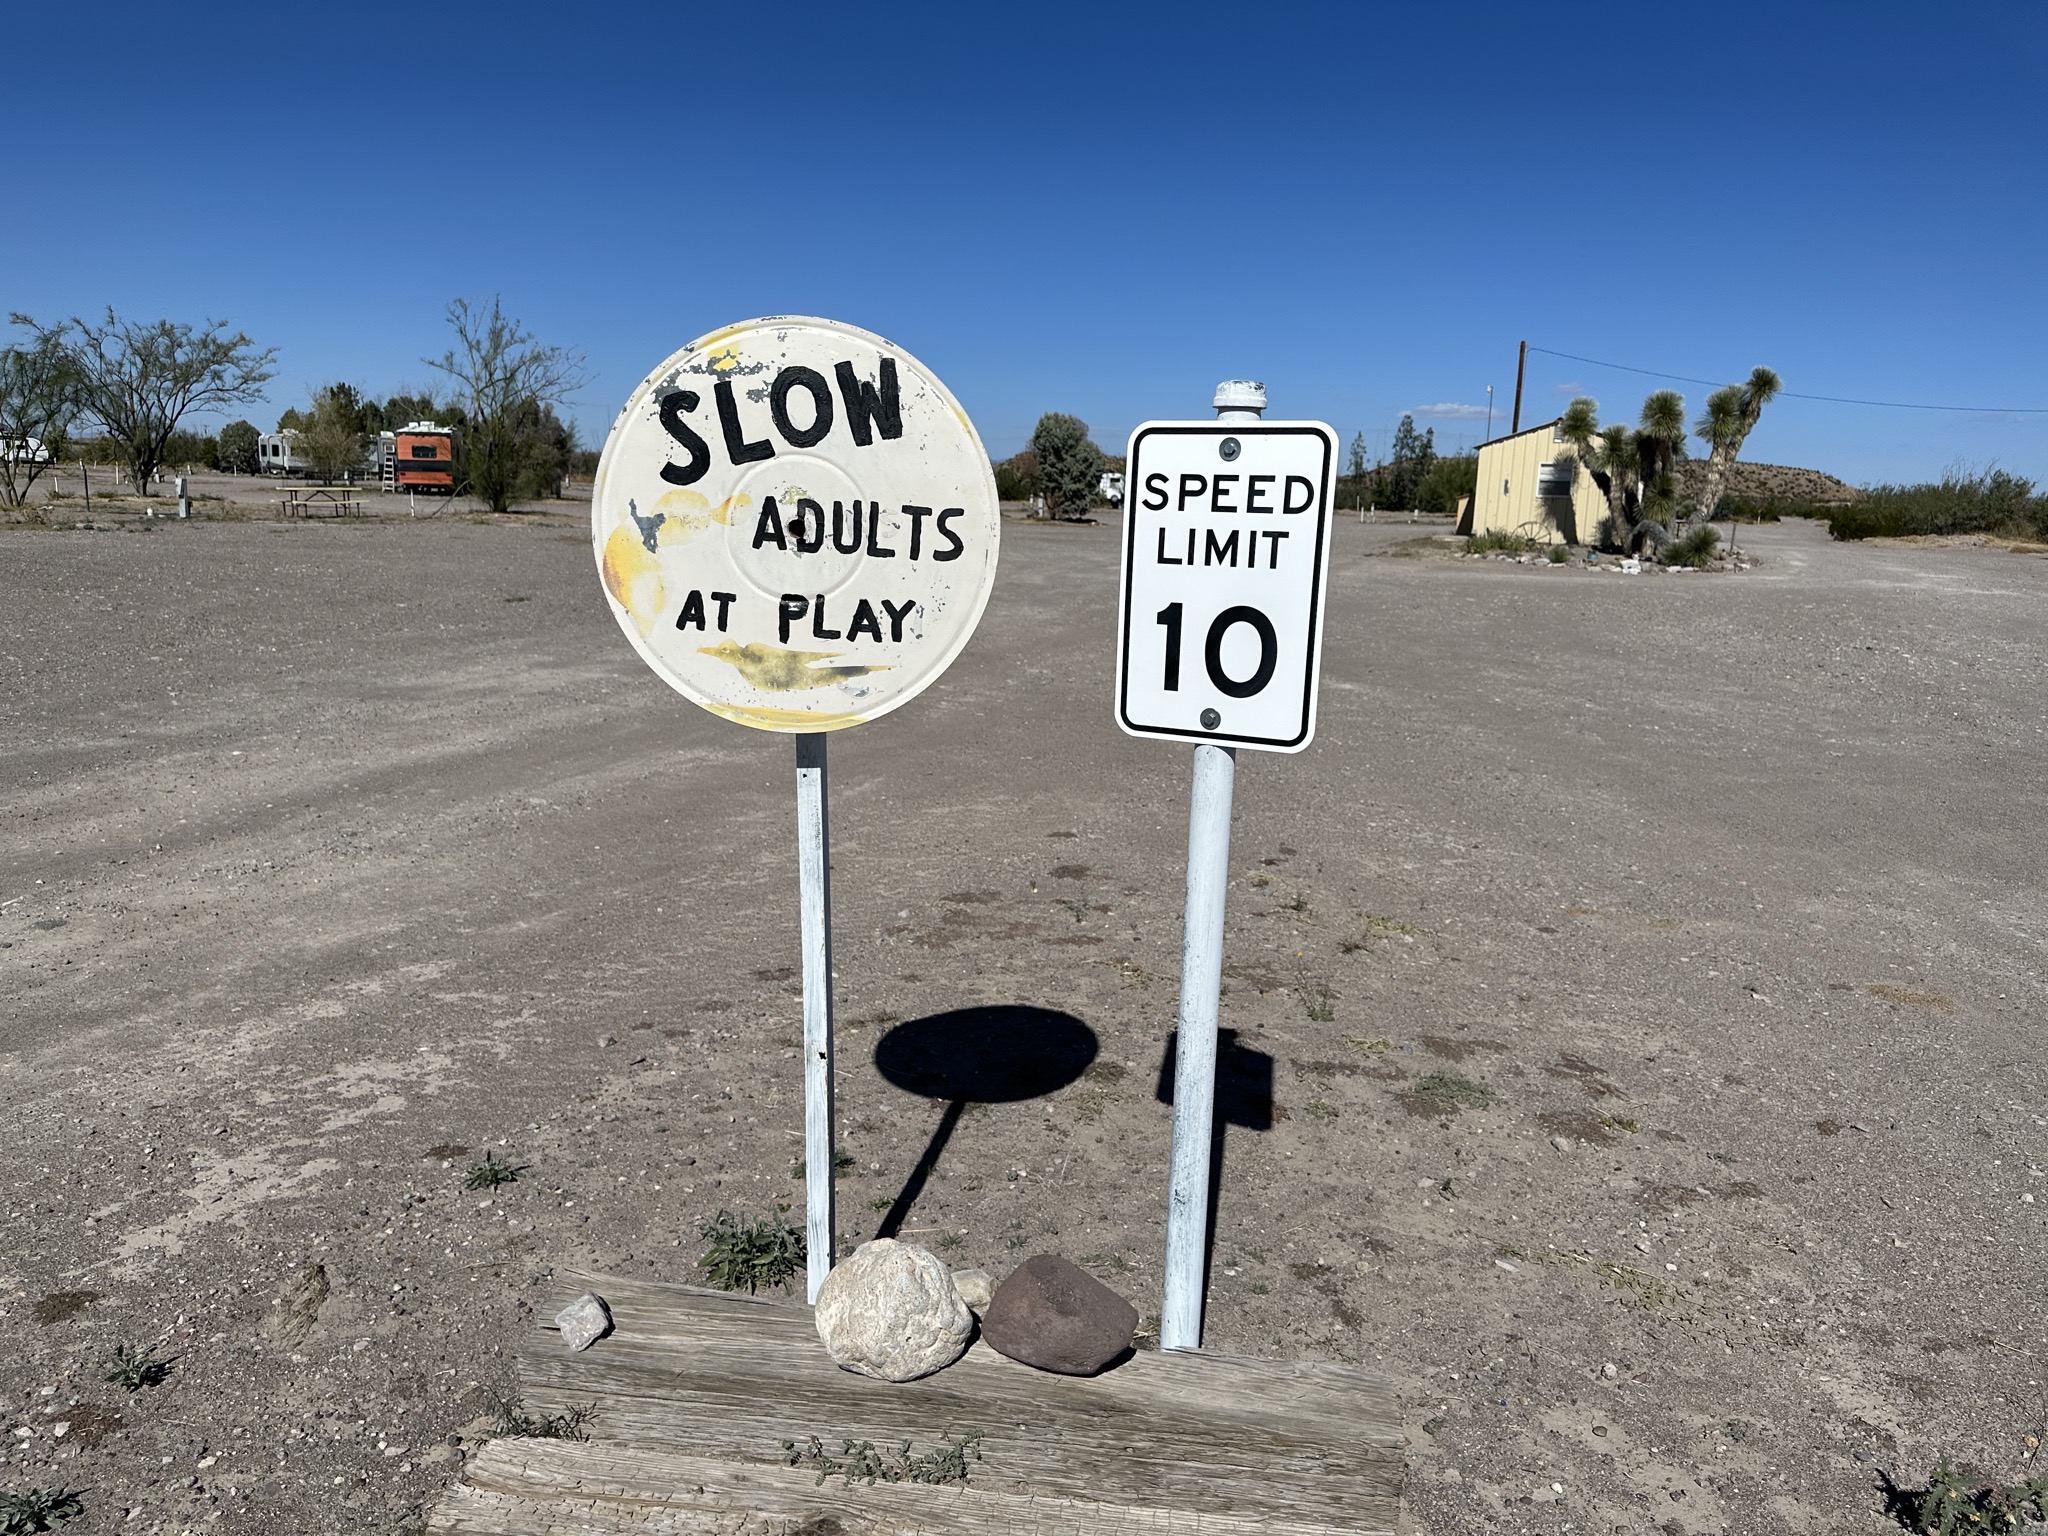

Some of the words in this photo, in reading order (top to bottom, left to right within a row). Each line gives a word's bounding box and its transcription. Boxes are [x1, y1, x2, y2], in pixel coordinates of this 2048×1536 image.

[659, 358, 903, 486] SLOW
[1142, 472, 1315, 515] SPEED
[752, 496, 965, 562] ADULTS
[1157, 527, 1290, 570] LIMIT
[675, 590, 737, 632] AT
[779, 593, 916, 644] PLAY
[1156, 602, 1278, 699] 10
